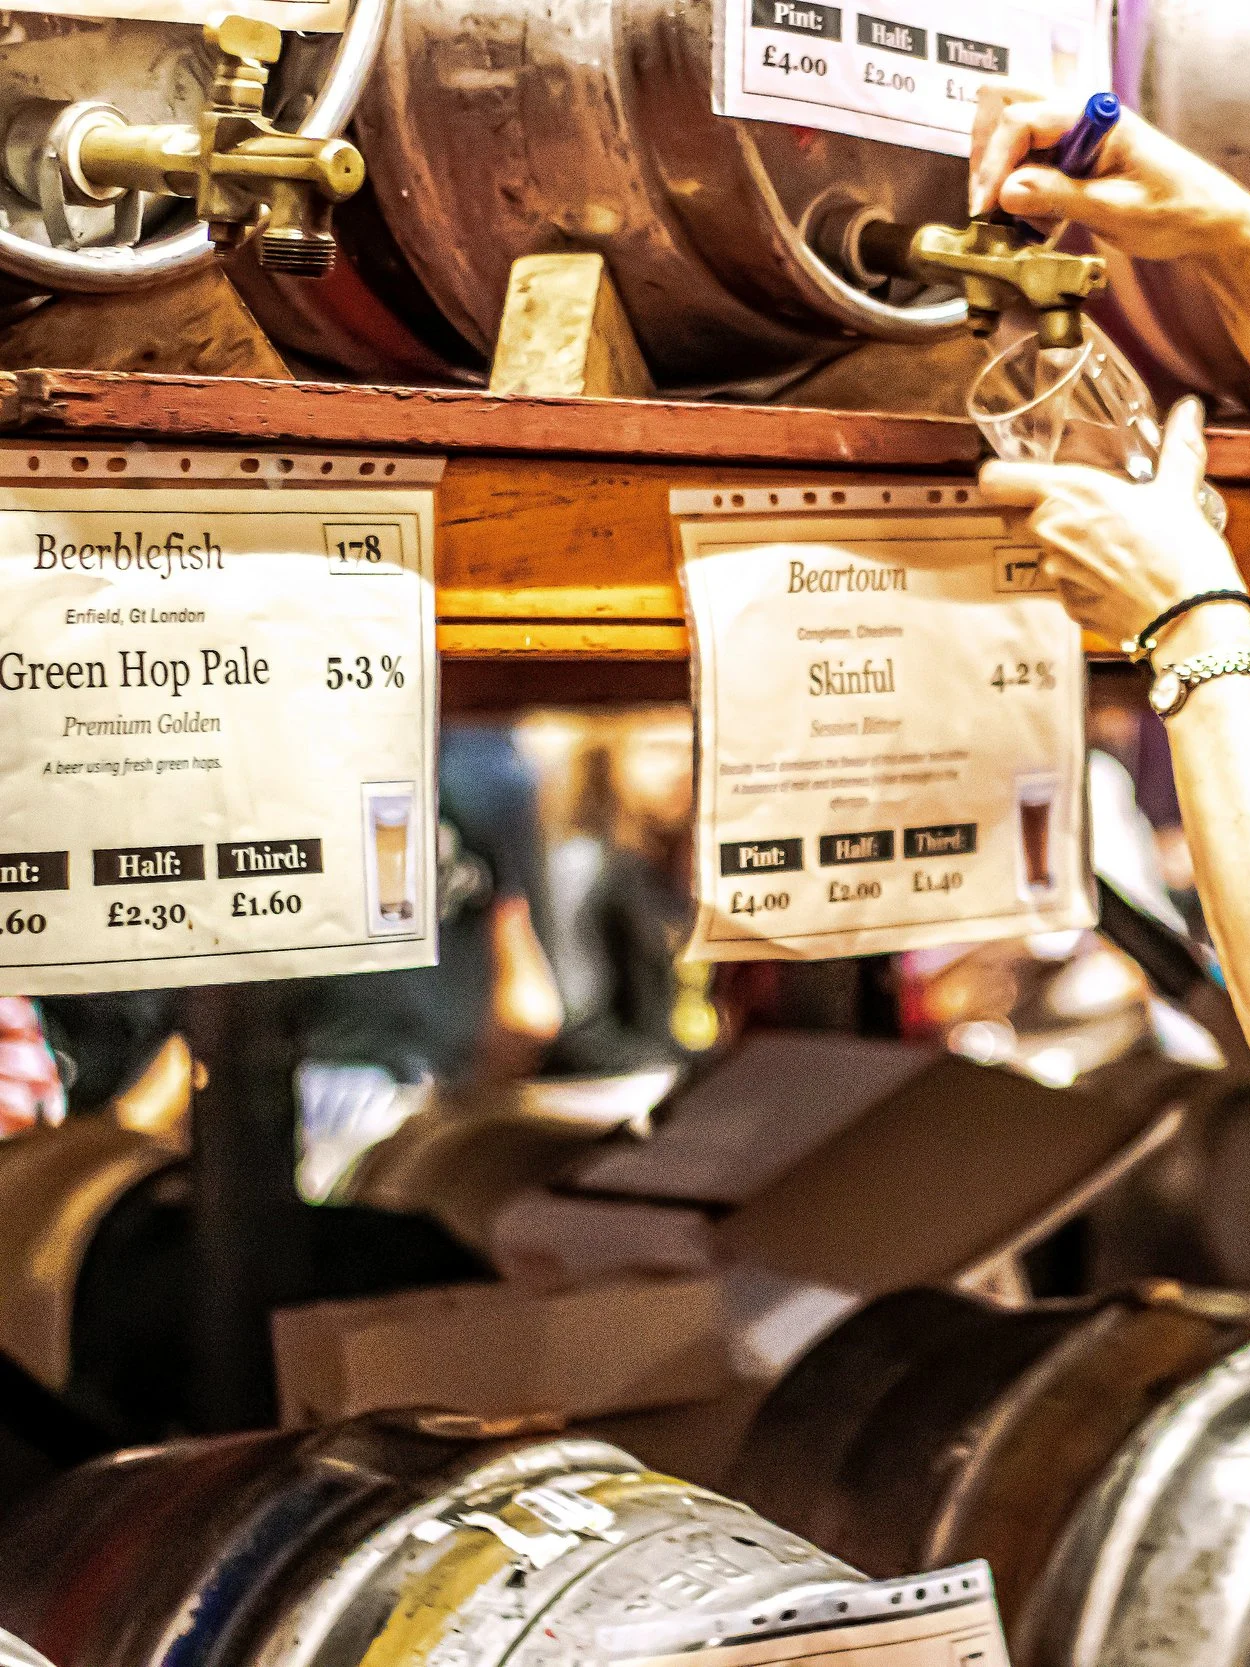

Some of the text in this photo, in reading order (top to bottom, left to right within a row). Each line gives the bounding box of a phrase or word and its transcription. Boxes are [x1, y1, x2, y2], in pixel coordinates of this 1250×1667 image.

[774, 2, 1000, 71] Pint: Half: Third:
[762, 45, 828, 77] £4.00
[863, 62, 916, 93] £2.00
[33, 531, 225, 580] Beerblefish
[335, 533, 382, 568] 178
[786, 560, 908, 594] Beartown
[65, 607, 206, 626] Enfield, Gt London
[0, 646, 271, 697] Green Hop Pale
[808, 658, 896, 697] Skinful
[62, 711, 222, 737] Premium Golden
[43, 762, 52, 775] A
[55, 761, 84, 774] beer
[86, 759, 120, 777] using
[120, 758, 154, 776] fresh
[155, 758, 190, 775] green
[117, 850, 182, 879] Half:
[231, 845, 308, 873] Third:
[738, 845, 786, 869] Pint:
[107, 901, 187, 930] £2.30
[231, 890, 303, 917] £1.60
[730, 871, 965, 917] £4.00 £2.00 £1.40
